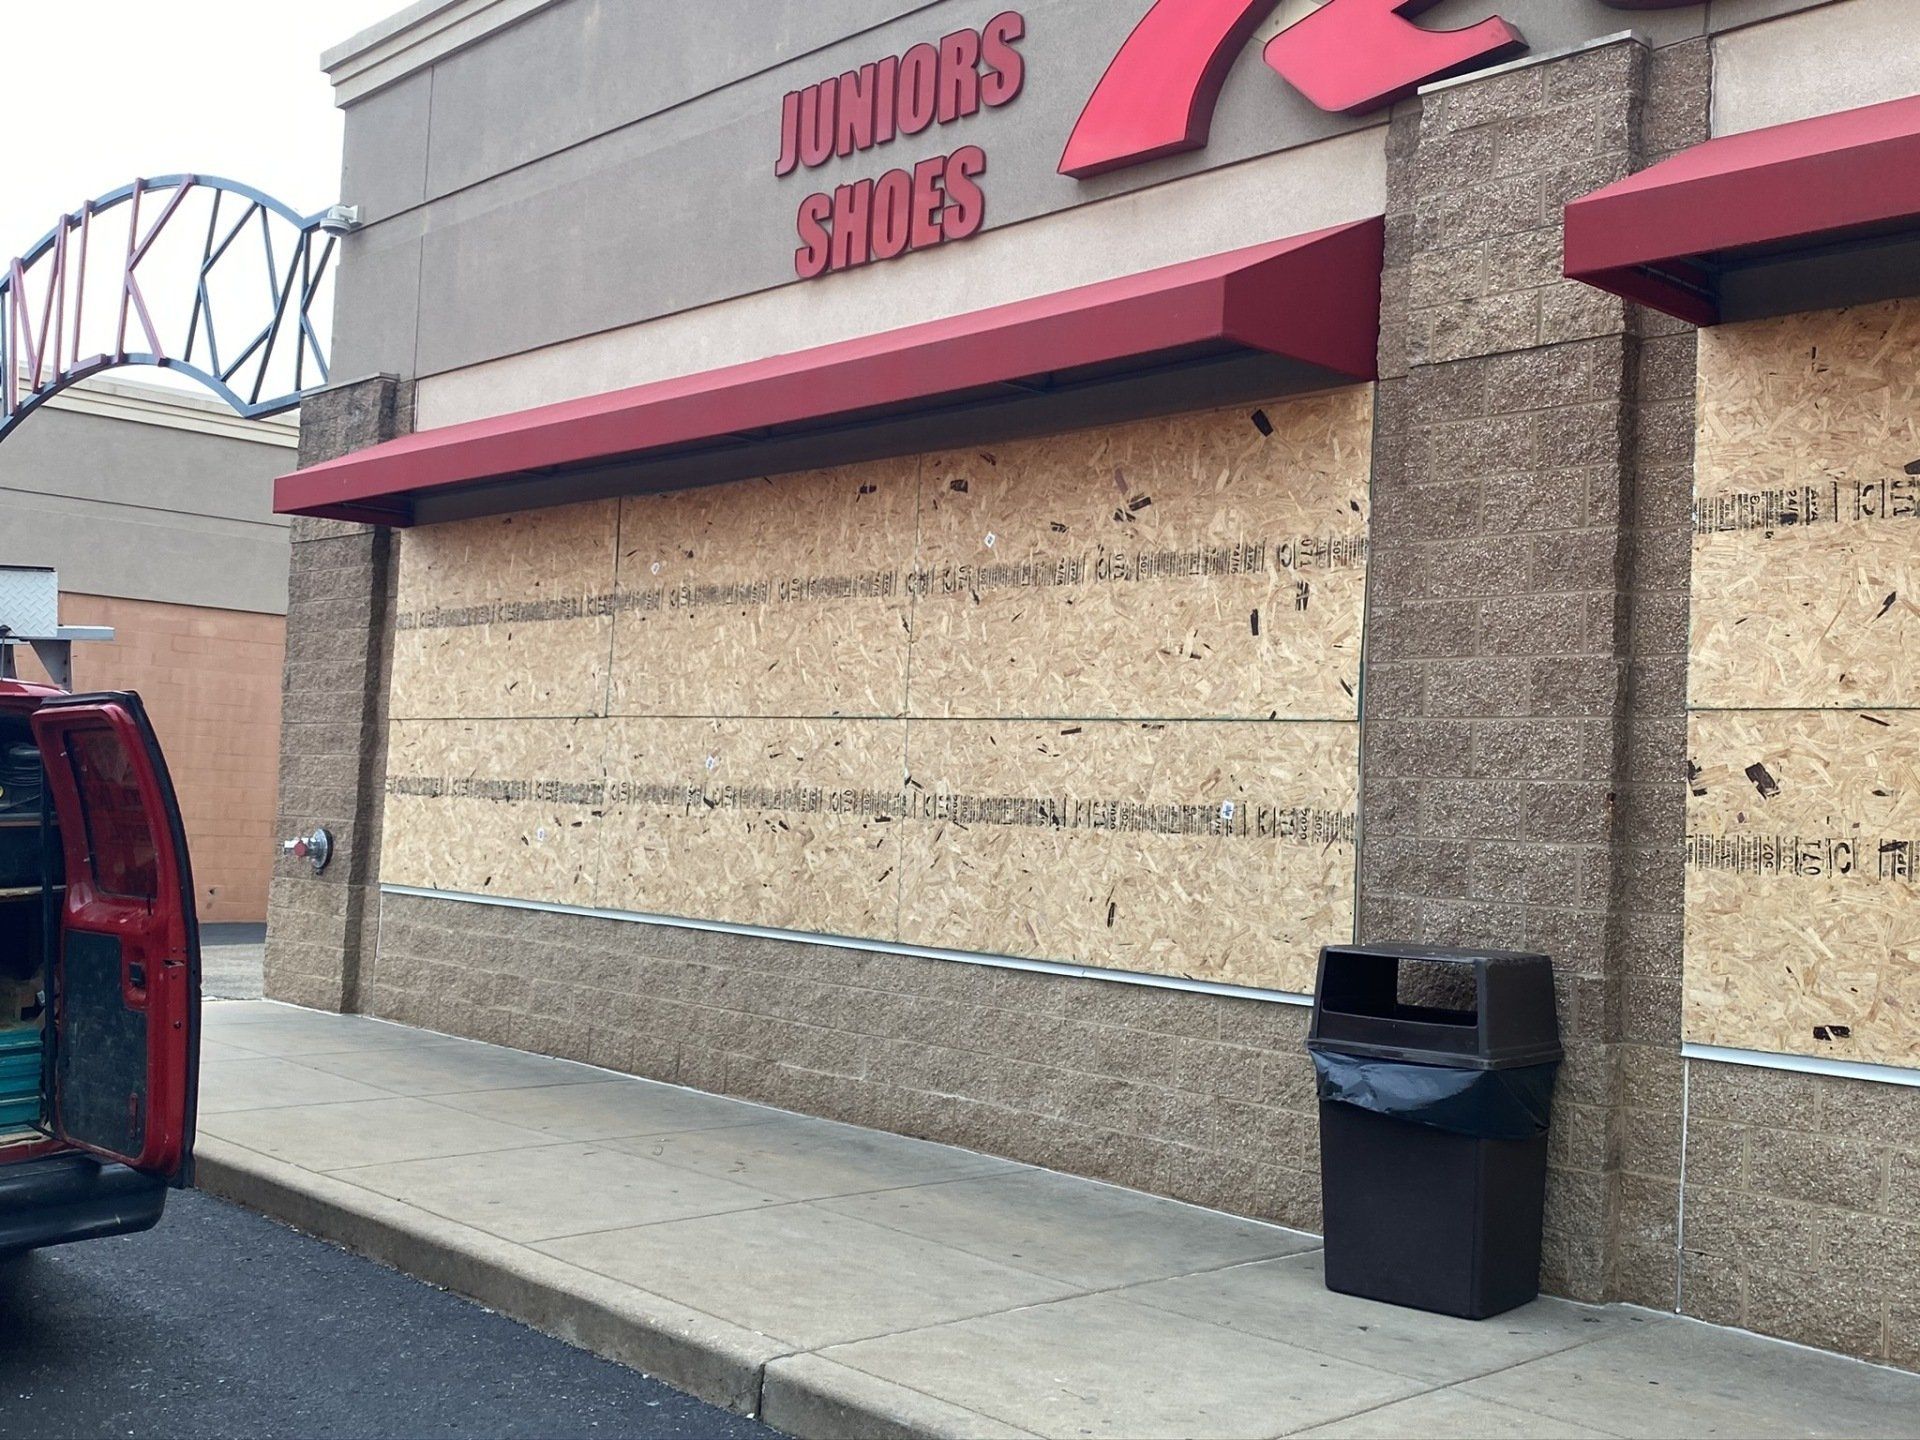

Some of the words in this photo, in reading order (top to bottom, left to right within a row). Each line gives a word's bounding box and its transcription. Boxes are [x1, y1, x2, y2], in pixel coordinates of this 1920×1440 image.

[774, 10, 1026, 177] JUNIORS
[795, 145, 986, 281] SHOES
[1786, 490, 1798, 526] 24/6
[1300, 539, 1313, 568] 071
[1803, 840, 1821, 876] 071
